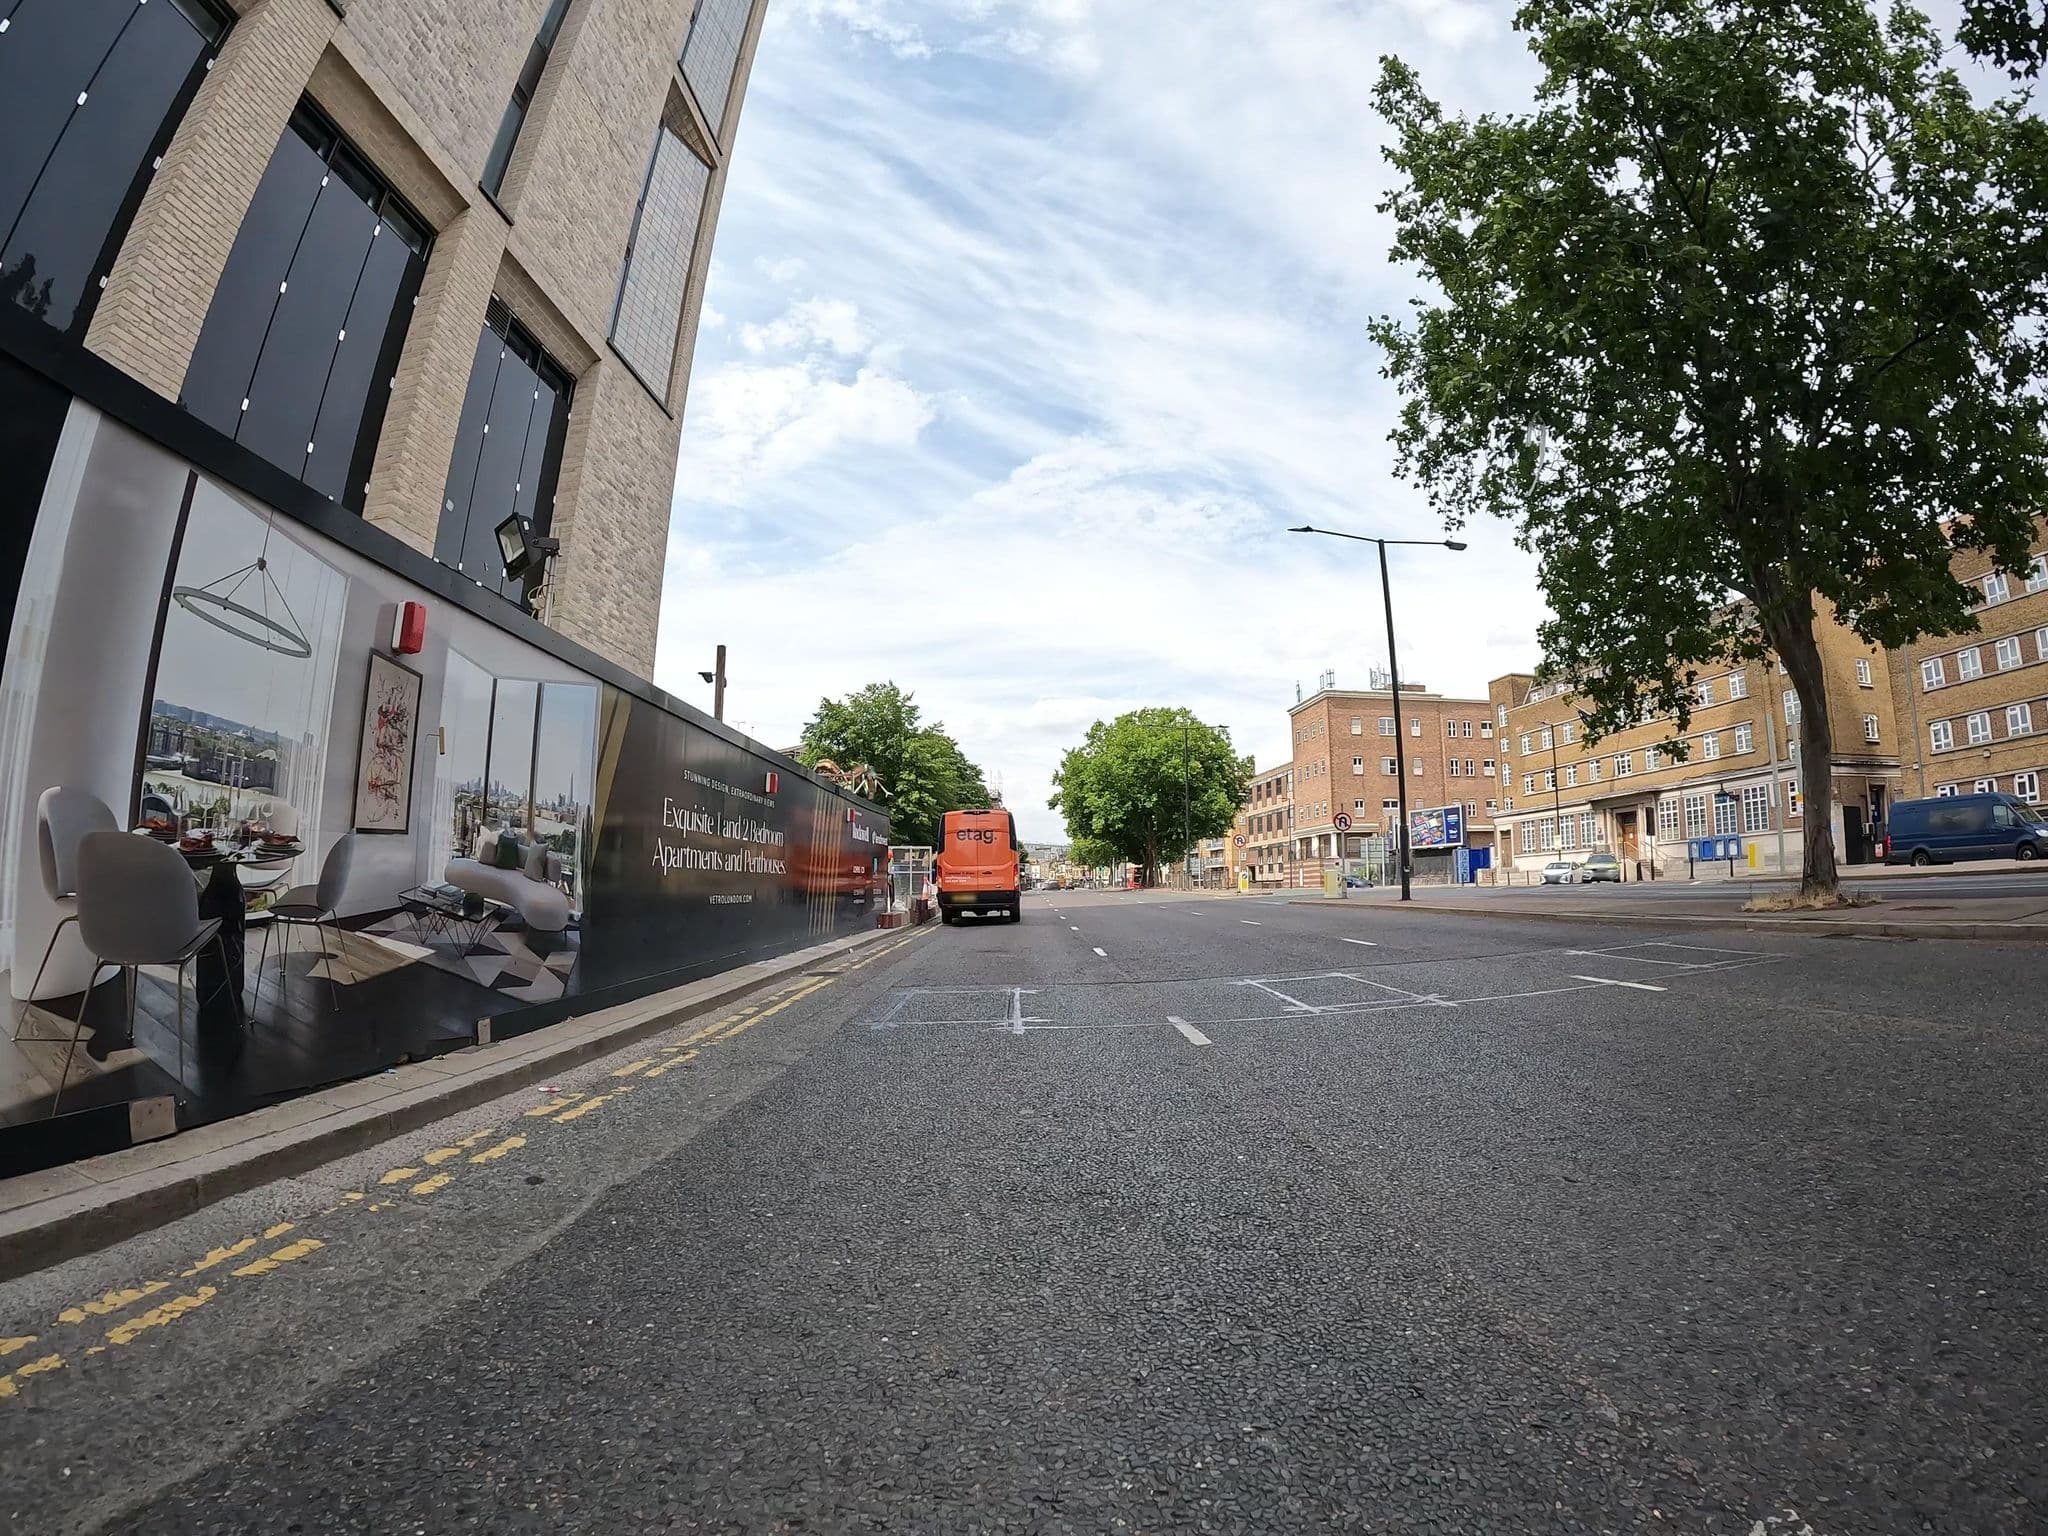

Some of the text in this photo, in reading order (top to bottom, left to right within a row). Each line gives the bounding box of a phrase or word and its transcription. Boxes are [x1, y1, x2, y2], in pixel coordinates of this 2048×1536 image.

[683, 769, 711, 788] STUNNING
[730, 786, 764, 805] EXTRAORDINARY
[663, 797, 715, 838] Exquisite
[722, 815, 741, 840] and
[742, 817, 749, 841] 2
[750, 820, 784, 847] Bedroom
[652, 837, 787, 876] Apartments and Penthouses
